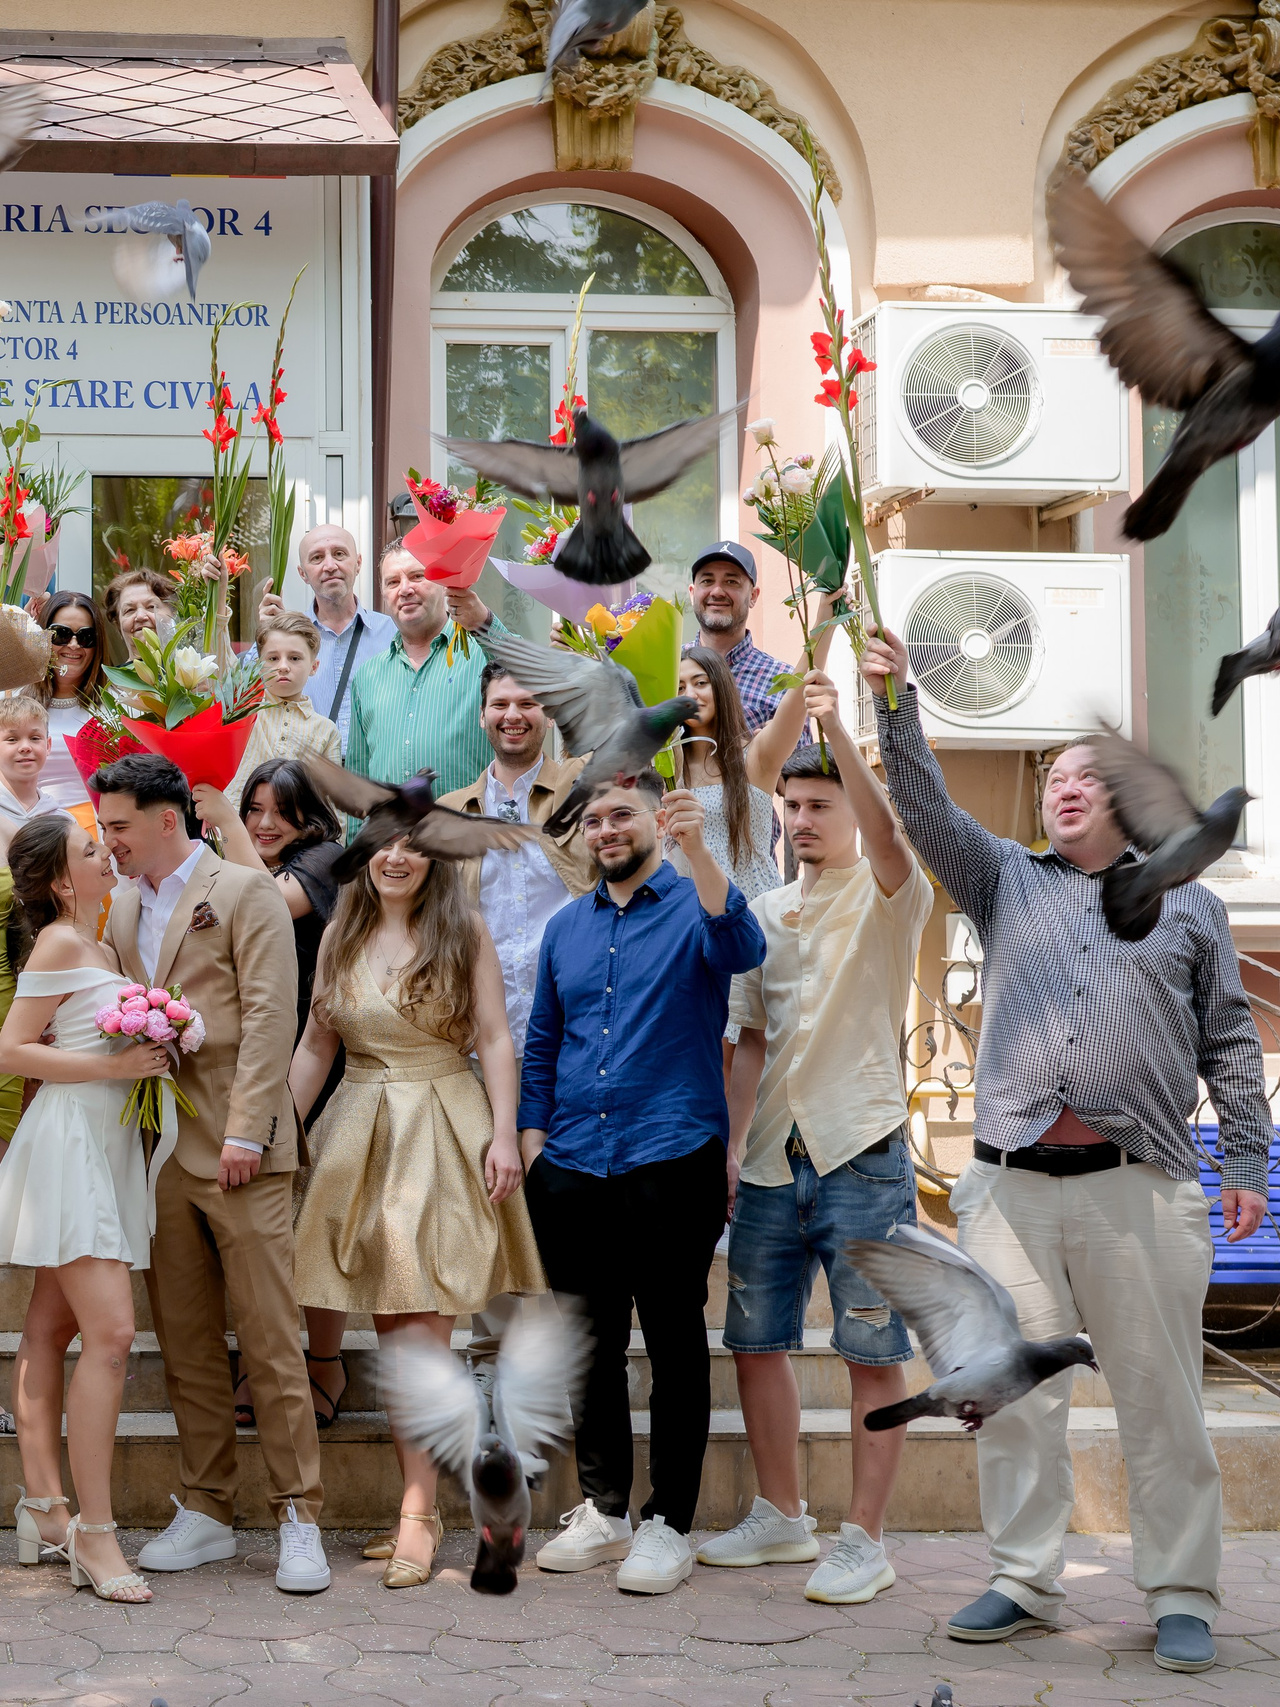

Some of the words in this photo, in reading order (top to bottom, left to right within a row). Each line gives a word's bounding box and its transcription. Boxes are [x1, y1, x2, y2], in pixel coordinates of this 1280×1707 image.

[84, 205, 244, 237] SEOR
[253, 210, 273, 237] 4
[70, 300, 89, 324] A
[94, 301, 271, 327] PERSOANELOR
[66, 339, 79, 361] 4
[24, 378, 135, 409] STARE
